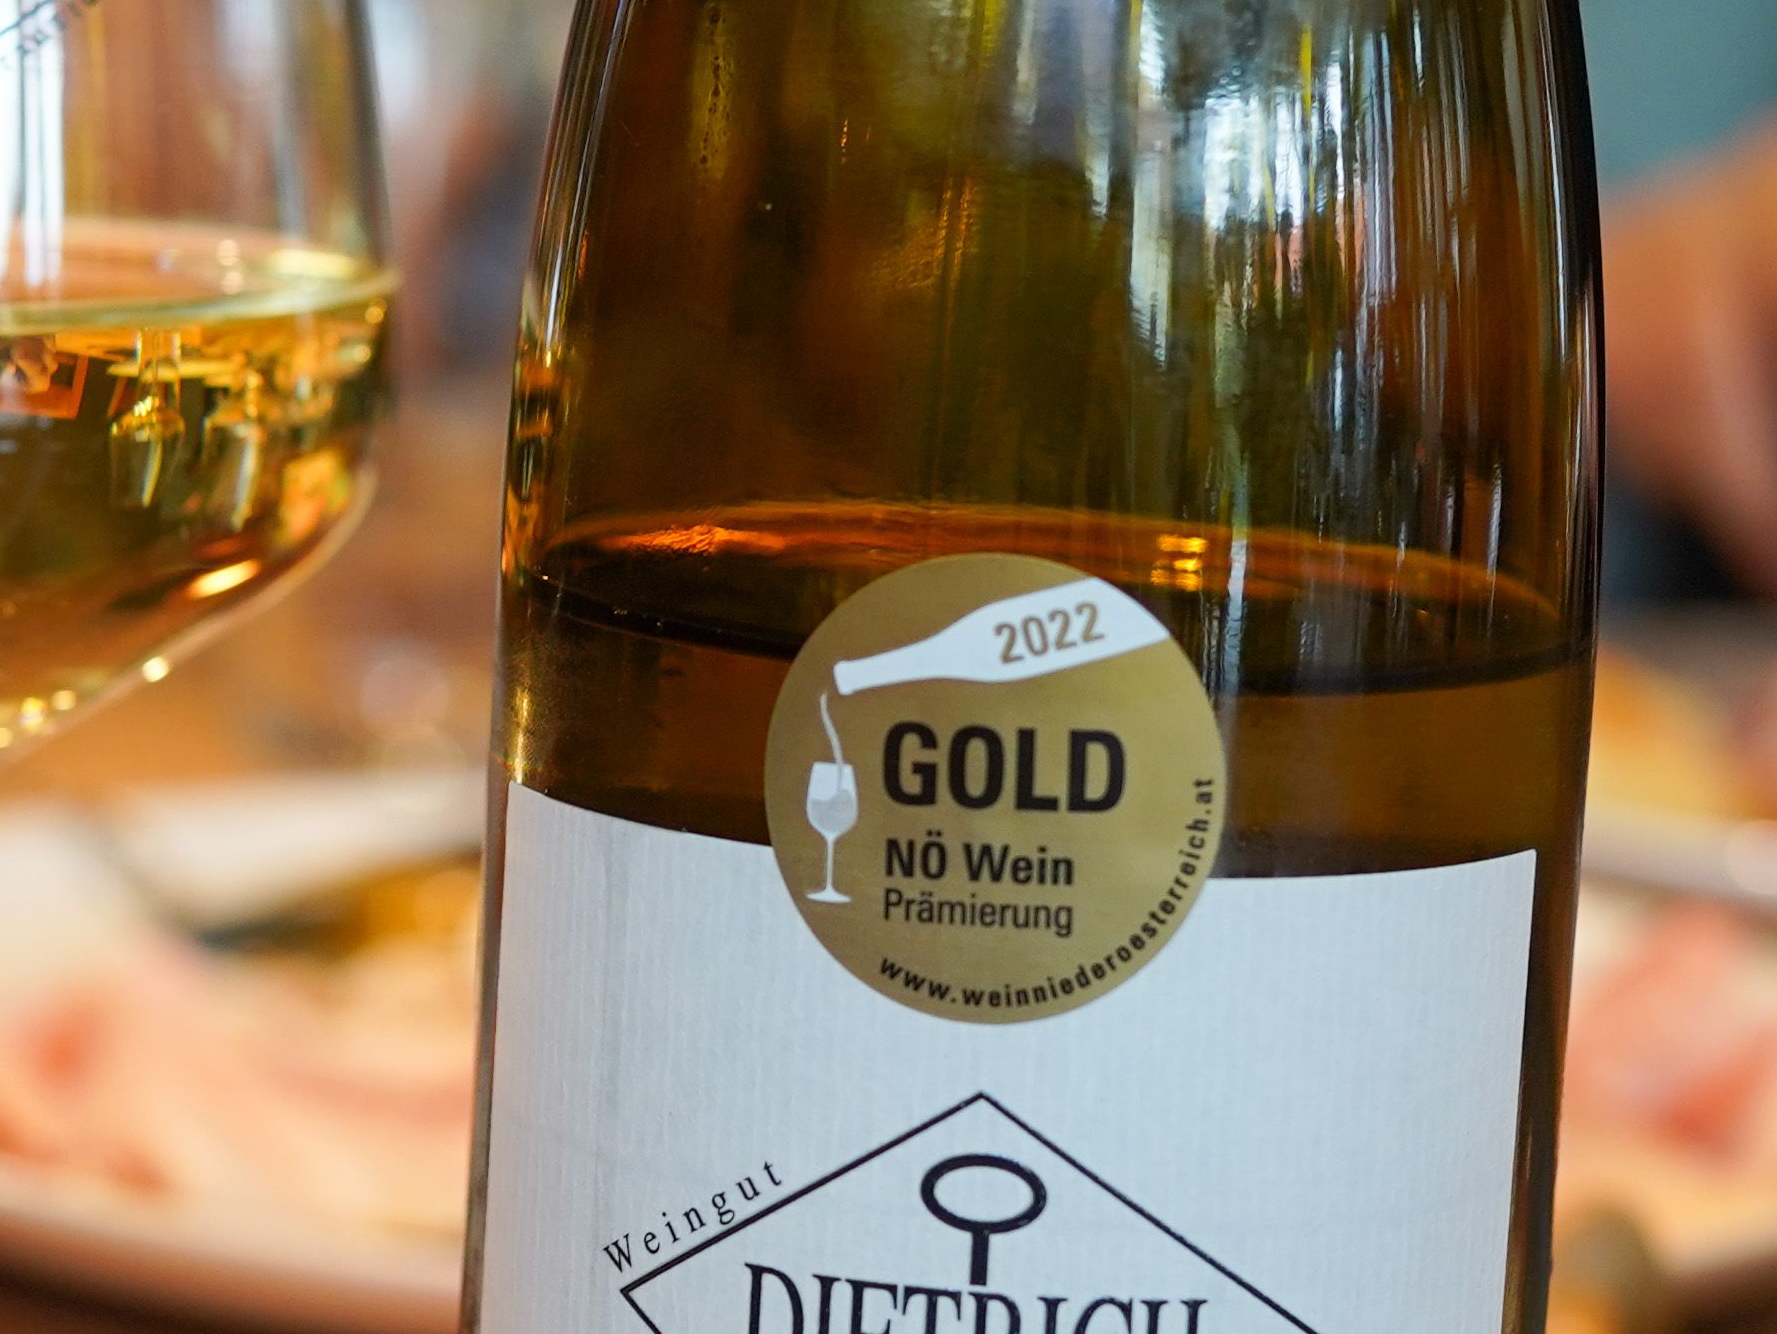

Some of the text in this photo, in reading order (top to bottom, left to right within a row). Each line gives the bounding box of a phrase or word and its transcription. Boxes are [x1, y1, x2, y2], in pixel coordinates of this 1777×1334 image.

[993, 601, 1106, 665] 2022
[881, 720, 1127, 814] GOLD
[878, 777, 1215, 1008] www.weinniederoesterreich.at
[884, 829, 1075, 887] NÖ Wein
[882, 887, 1075, 939] Prämierung
[602, 1158, 785, 1276] Weingut
